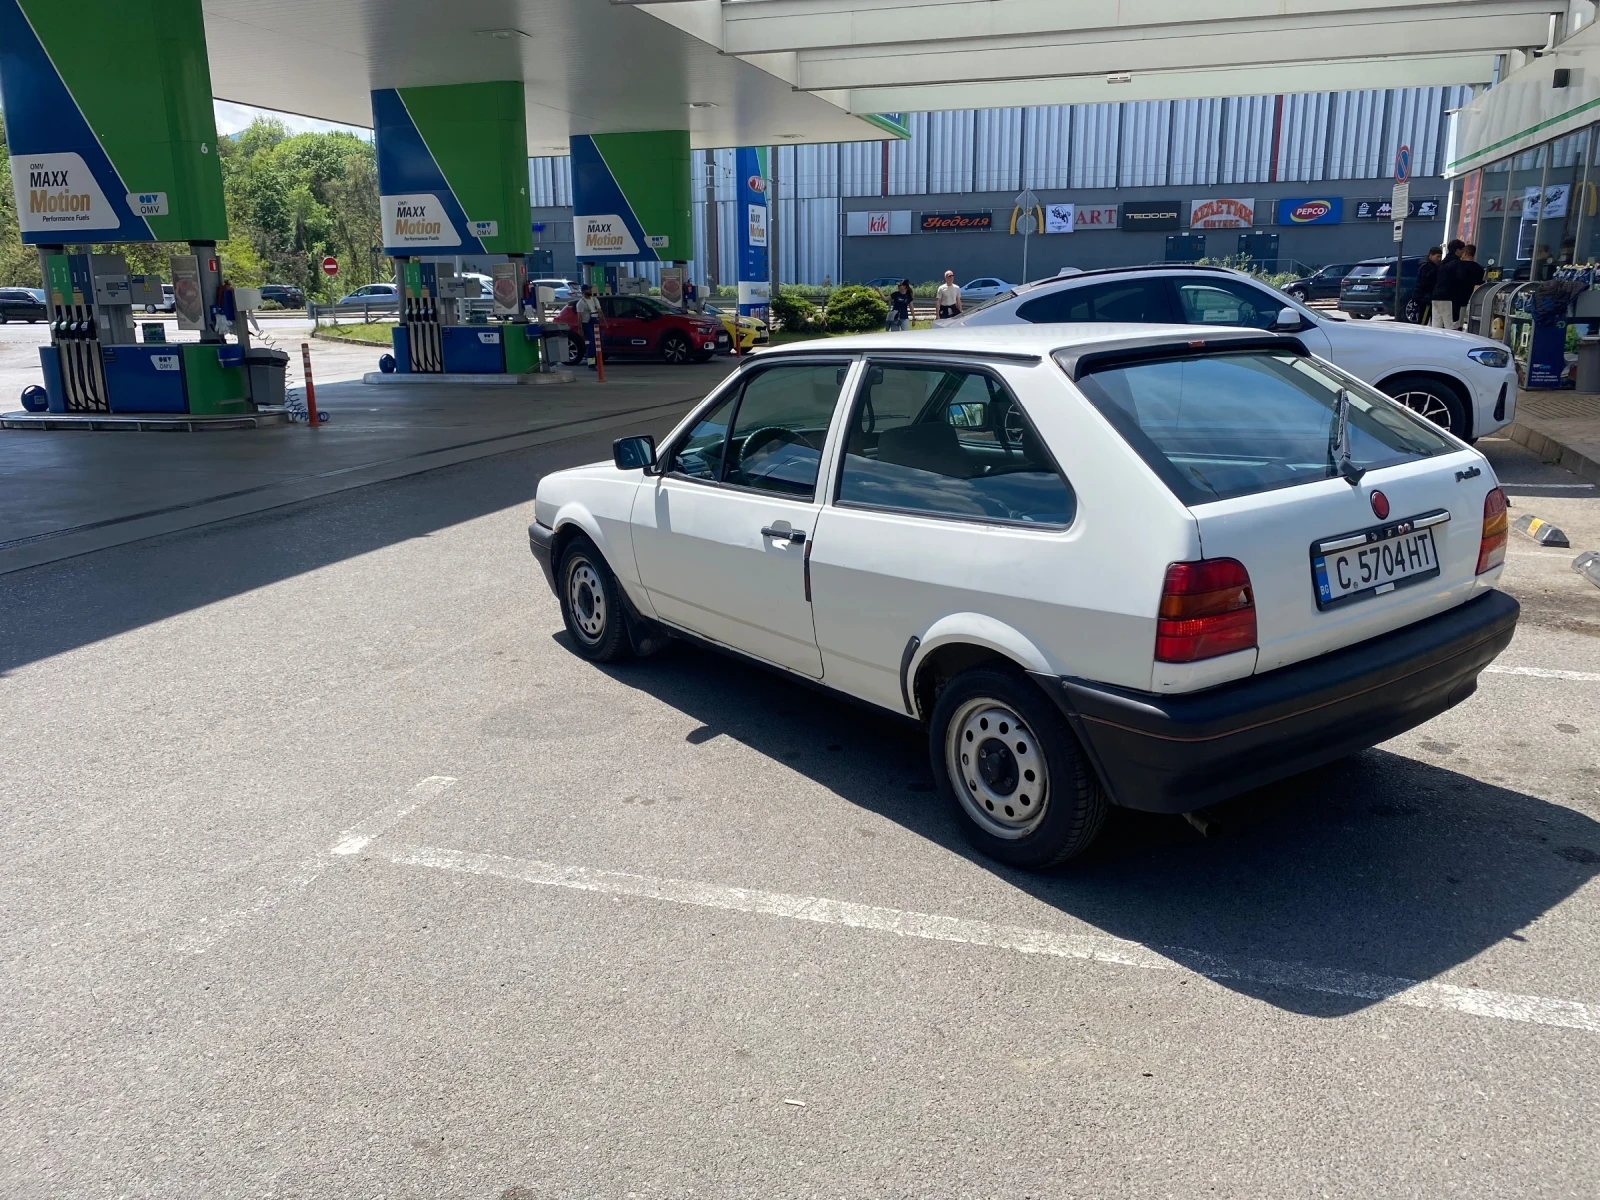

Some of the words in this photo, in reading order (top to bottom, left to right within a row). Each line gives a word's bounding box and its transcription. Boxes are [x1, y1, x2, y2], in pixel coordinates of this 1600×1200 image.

[200, 143, 209, 154] 6
[30, 163, 44, 171] OMV
[30, 171, 69, 188] MAXX
[520, 187, 526, 196] 4
[29, 189, 91, 214] Motion
[139, 194, 158, 204] OMV
[140, 206, 160, 215] OMV
[396, 206, 426, 218] MAXX
[1126, 212, 1178, 220] TEODOR
[1296, 207, 1326, 216] PEPCO
[923, 216, 990, 228] Неделя
[1075, 209, 1117, 225] ART
[395, 219, 441, 235] Motion
[587, 223, 612, 233] MAXX
[869, 215, 888, 232] kik
[585, 233, 624, 247] Motion
[1336, 556, 1352, 590] C
[1357, 541, 1406, 583] 5704
[1405, 533, 1430, 570] HT
[1320, 584, 1330, 595] BG
